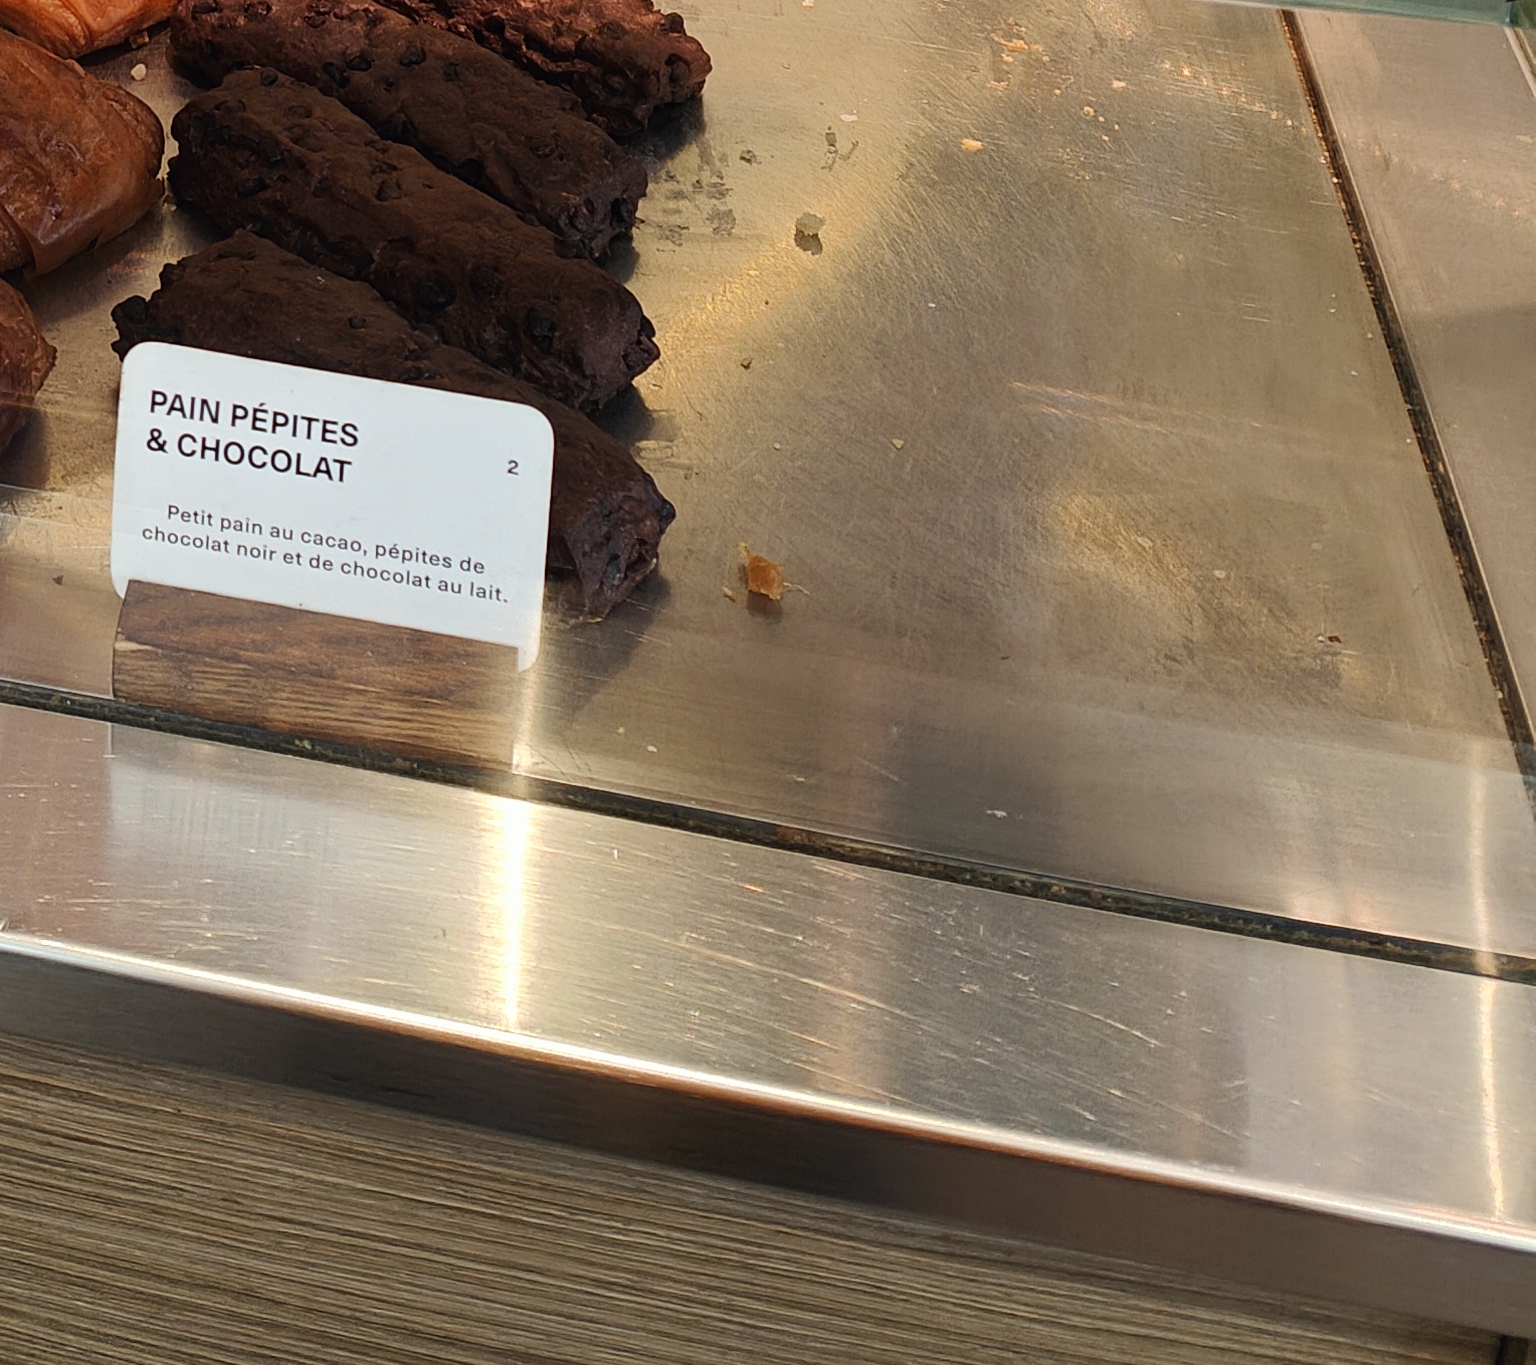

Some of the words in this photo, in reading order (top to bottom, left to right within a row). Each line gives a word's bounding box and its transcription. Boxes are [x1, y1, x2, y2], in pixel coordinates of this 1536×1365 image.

[149, 390, 221, 425] PAIN
[230, 402, 360, 448] PÉPITES
[146, 429, 169, 455] &
[176, 433, 353, 483] CHOCOLAT
[507, 459, 520, 475] 2
[141, 526, 230, 556] chocolat
[236, 539, 278, 563] noir
[283, 549, 304, 566] et
[308, 551, 334, 571] de
[340, 559, 432, 590] chocolat
[437, 577, 463, 595] au
[469, 581, 509, 603] lait.
[167, 504, 214, 528] Petit
[219, 515, 264, 541] pain
[269, 525, 294, 542] au
[300, 530, 368, 557] cacao,
[374, 541, 453, 574] pépites
[459, 555, 486, 575] de
